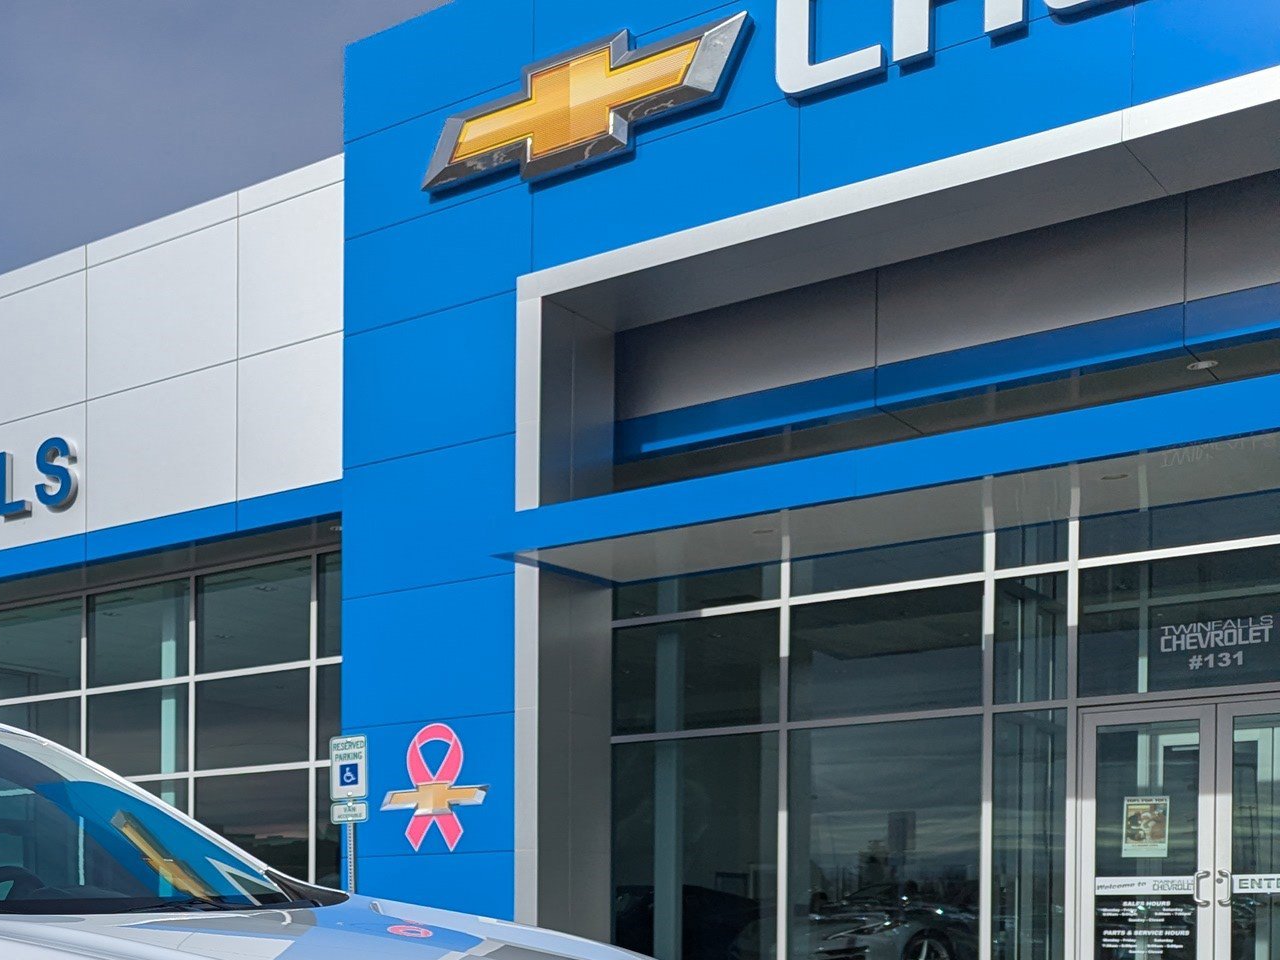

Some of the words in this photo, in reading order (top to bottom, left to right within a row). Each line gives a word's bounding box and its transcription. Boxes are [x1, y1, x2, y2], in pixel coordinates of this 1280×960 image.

[1160, 615, 1274, 636] TWINFALLS
[1160, 625, 1273, 653] CHEVROLET
[1188, 651, 1244, 670] #131
[332, 741, 365, 751] RESERVED
[334, 752, 363, 762] PARKING
[1096, 883, 1135, 891] Welcome
